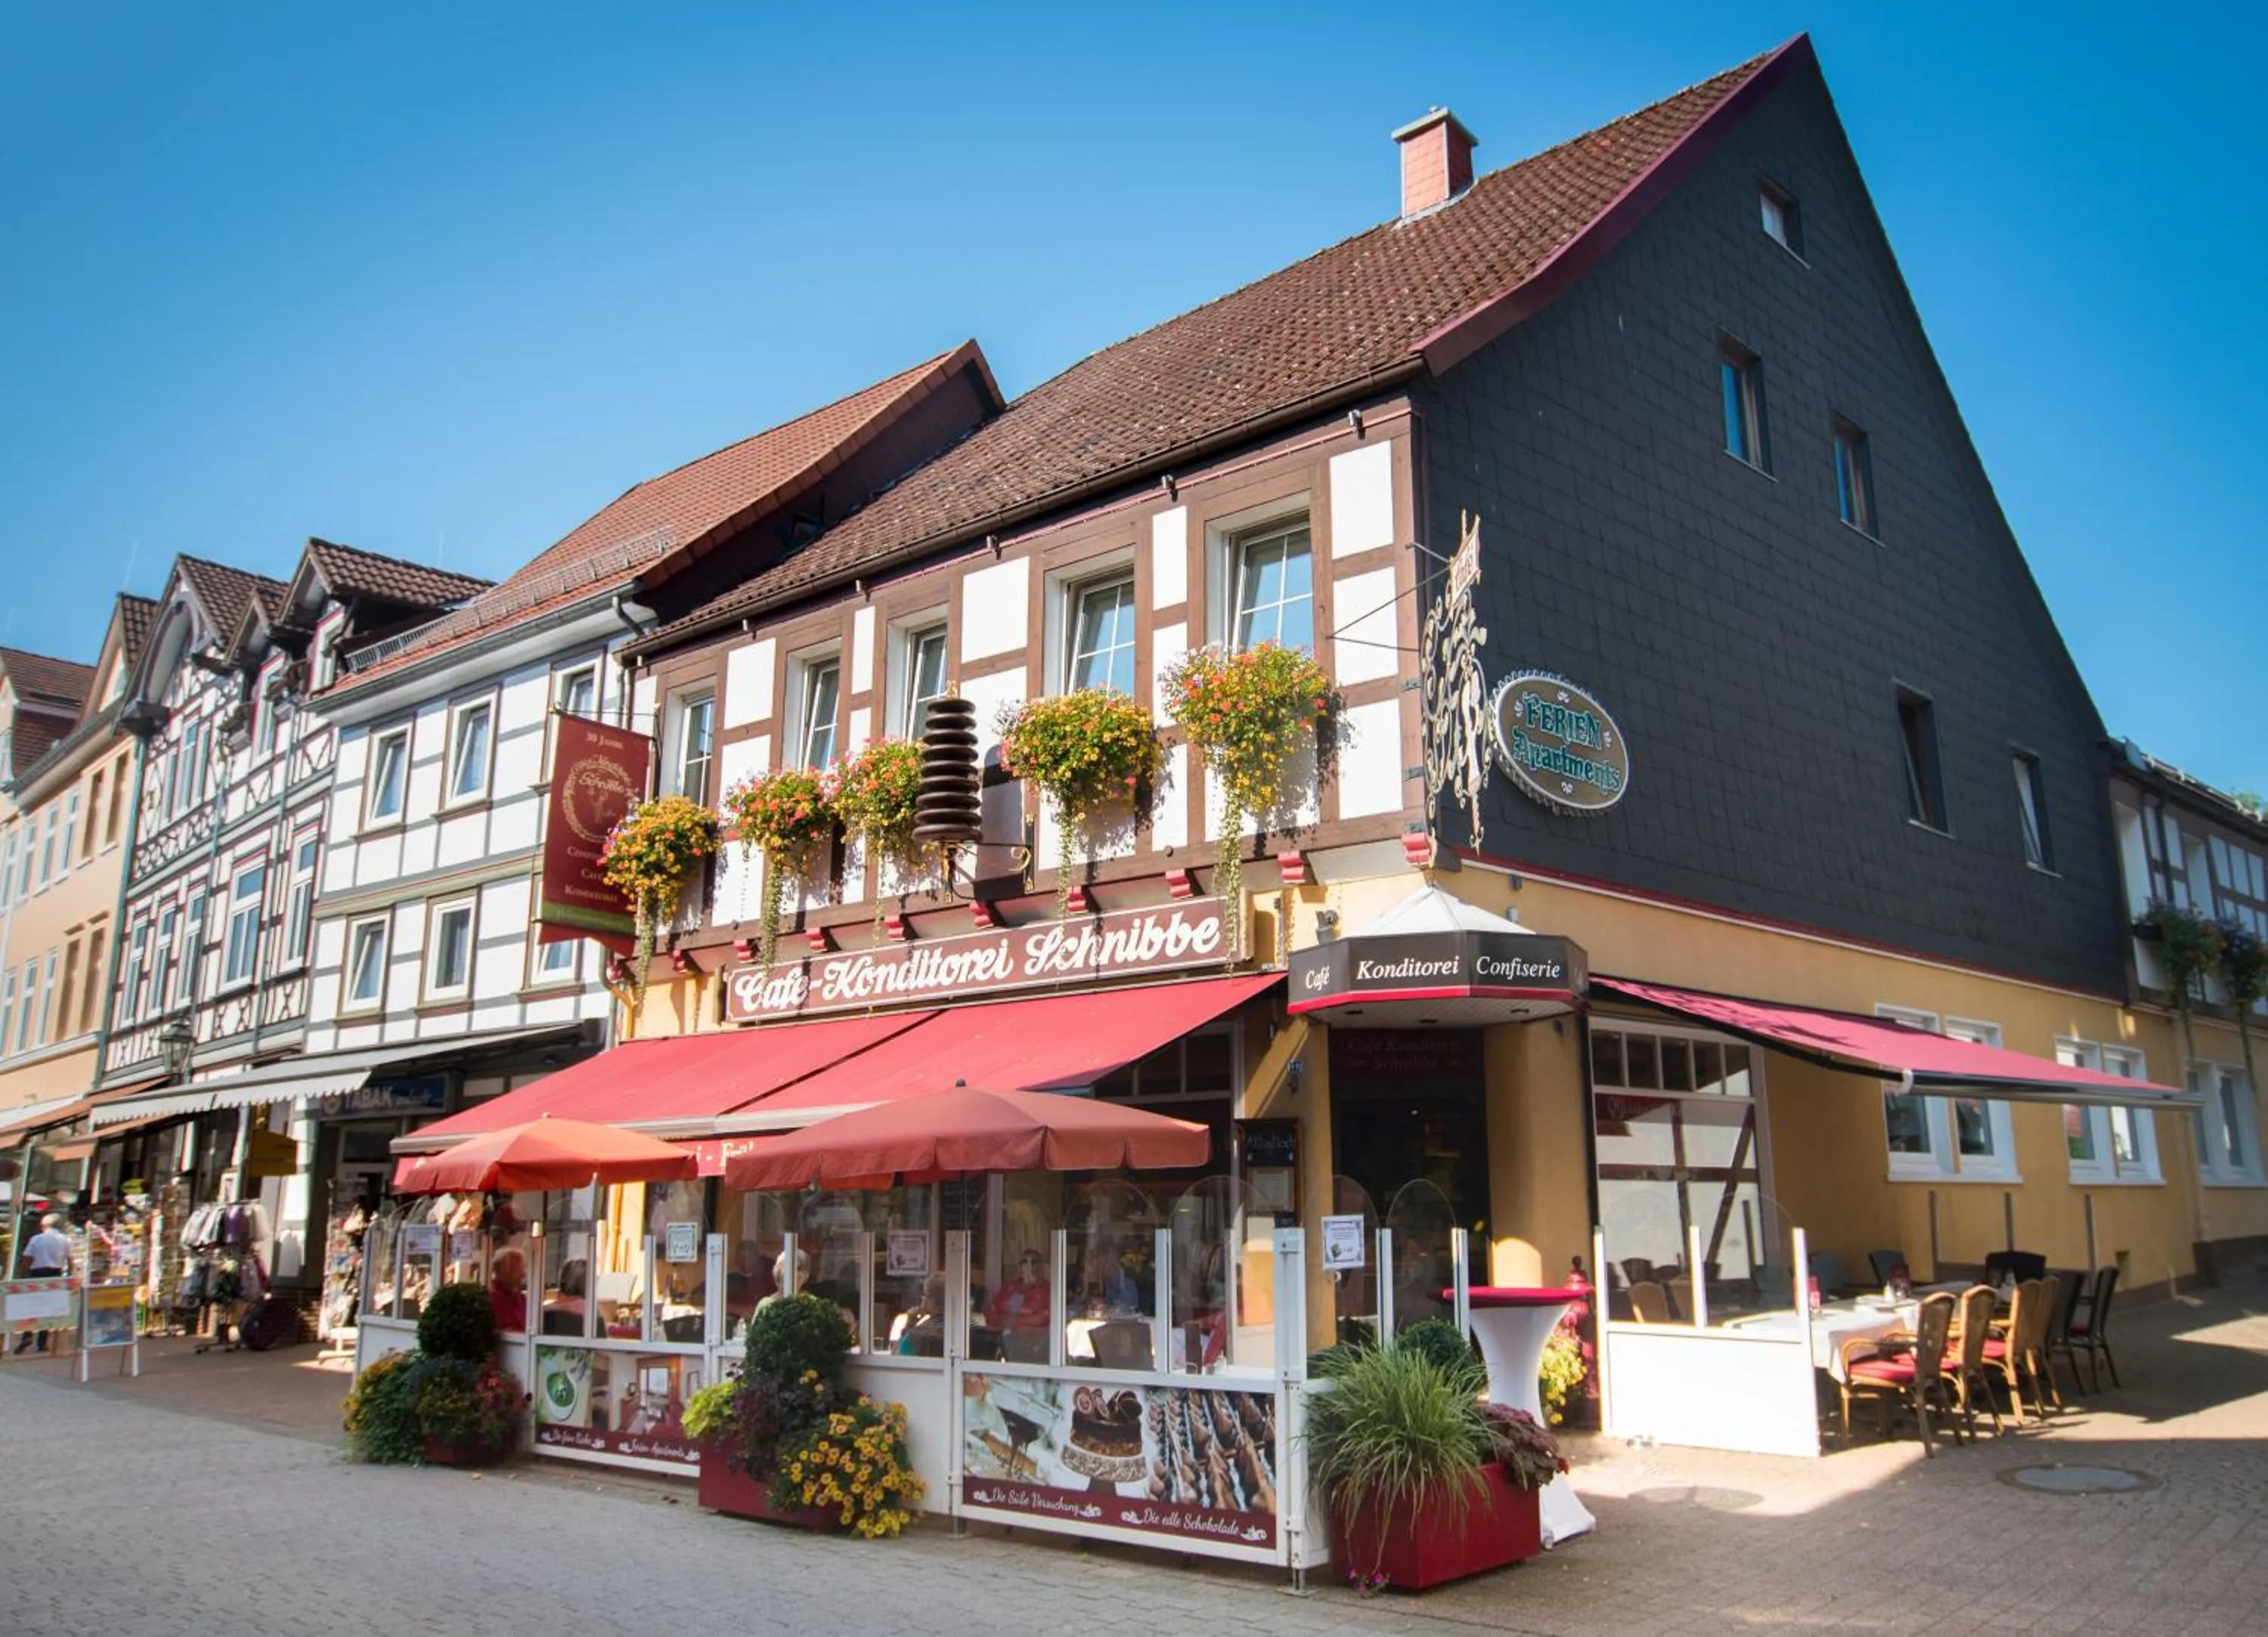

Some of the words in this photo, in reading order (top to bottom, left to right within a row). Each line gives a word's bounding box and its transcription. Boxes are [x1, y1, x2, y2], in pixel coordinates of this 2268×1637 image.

[1522, 692, 1602, 750] FERIEN
[1512, 726, 1621, 796] Apartments
[1025, 911, 1221, 974] Schnibbe
[1306, 966, 1330, 991] Café
[1357, 955, 1460, 980] Konditorei
[1476, 956, 1560, 980] Confiserie
[991, 1487, 1005, 1502] Die
[1142, 1507, 1160, 1524] Die
[1162, 1511, 1180, 1527] edle
[1184, 1512, 1239, 1536] Schokolade
